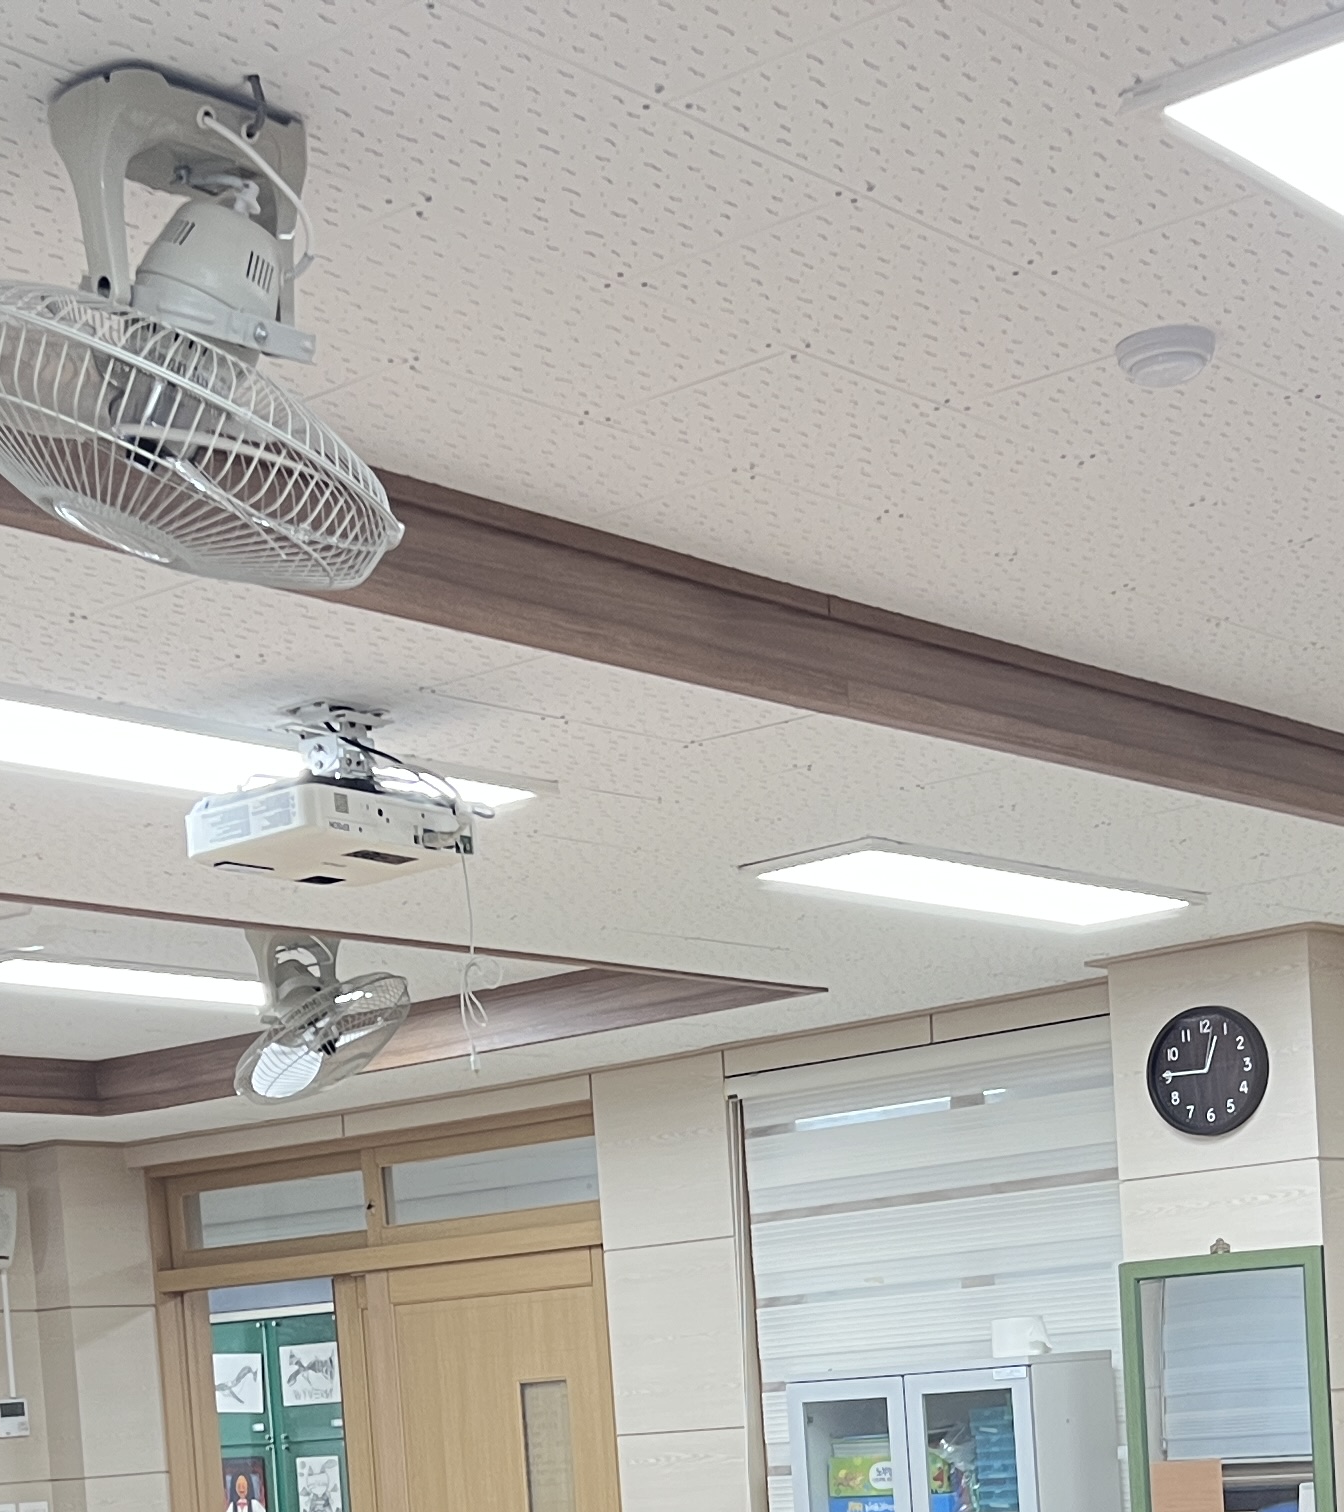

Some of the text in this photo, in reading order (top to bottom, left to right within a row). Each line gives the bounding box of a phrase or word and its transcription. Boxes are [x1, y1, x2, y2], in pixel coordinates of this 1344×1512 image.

[1199, 1019, 1211, 1033] 12
[1181, 1029, 1191, 1042] 11
[1236, 1036, 1245, 1050] 2
[1167, 1047, 1179, 1061] 10
[1243, 1057, 1253, 1072] 3
[1239, 1081, 1249, 1094] 4
[1170, 1091, 1180, 1106] 8
[1186, 1105, 1195, 1119] 7
[1226, 1099, 1236, 1113] 5
[1206, 1108, 1216, 1122] 6
